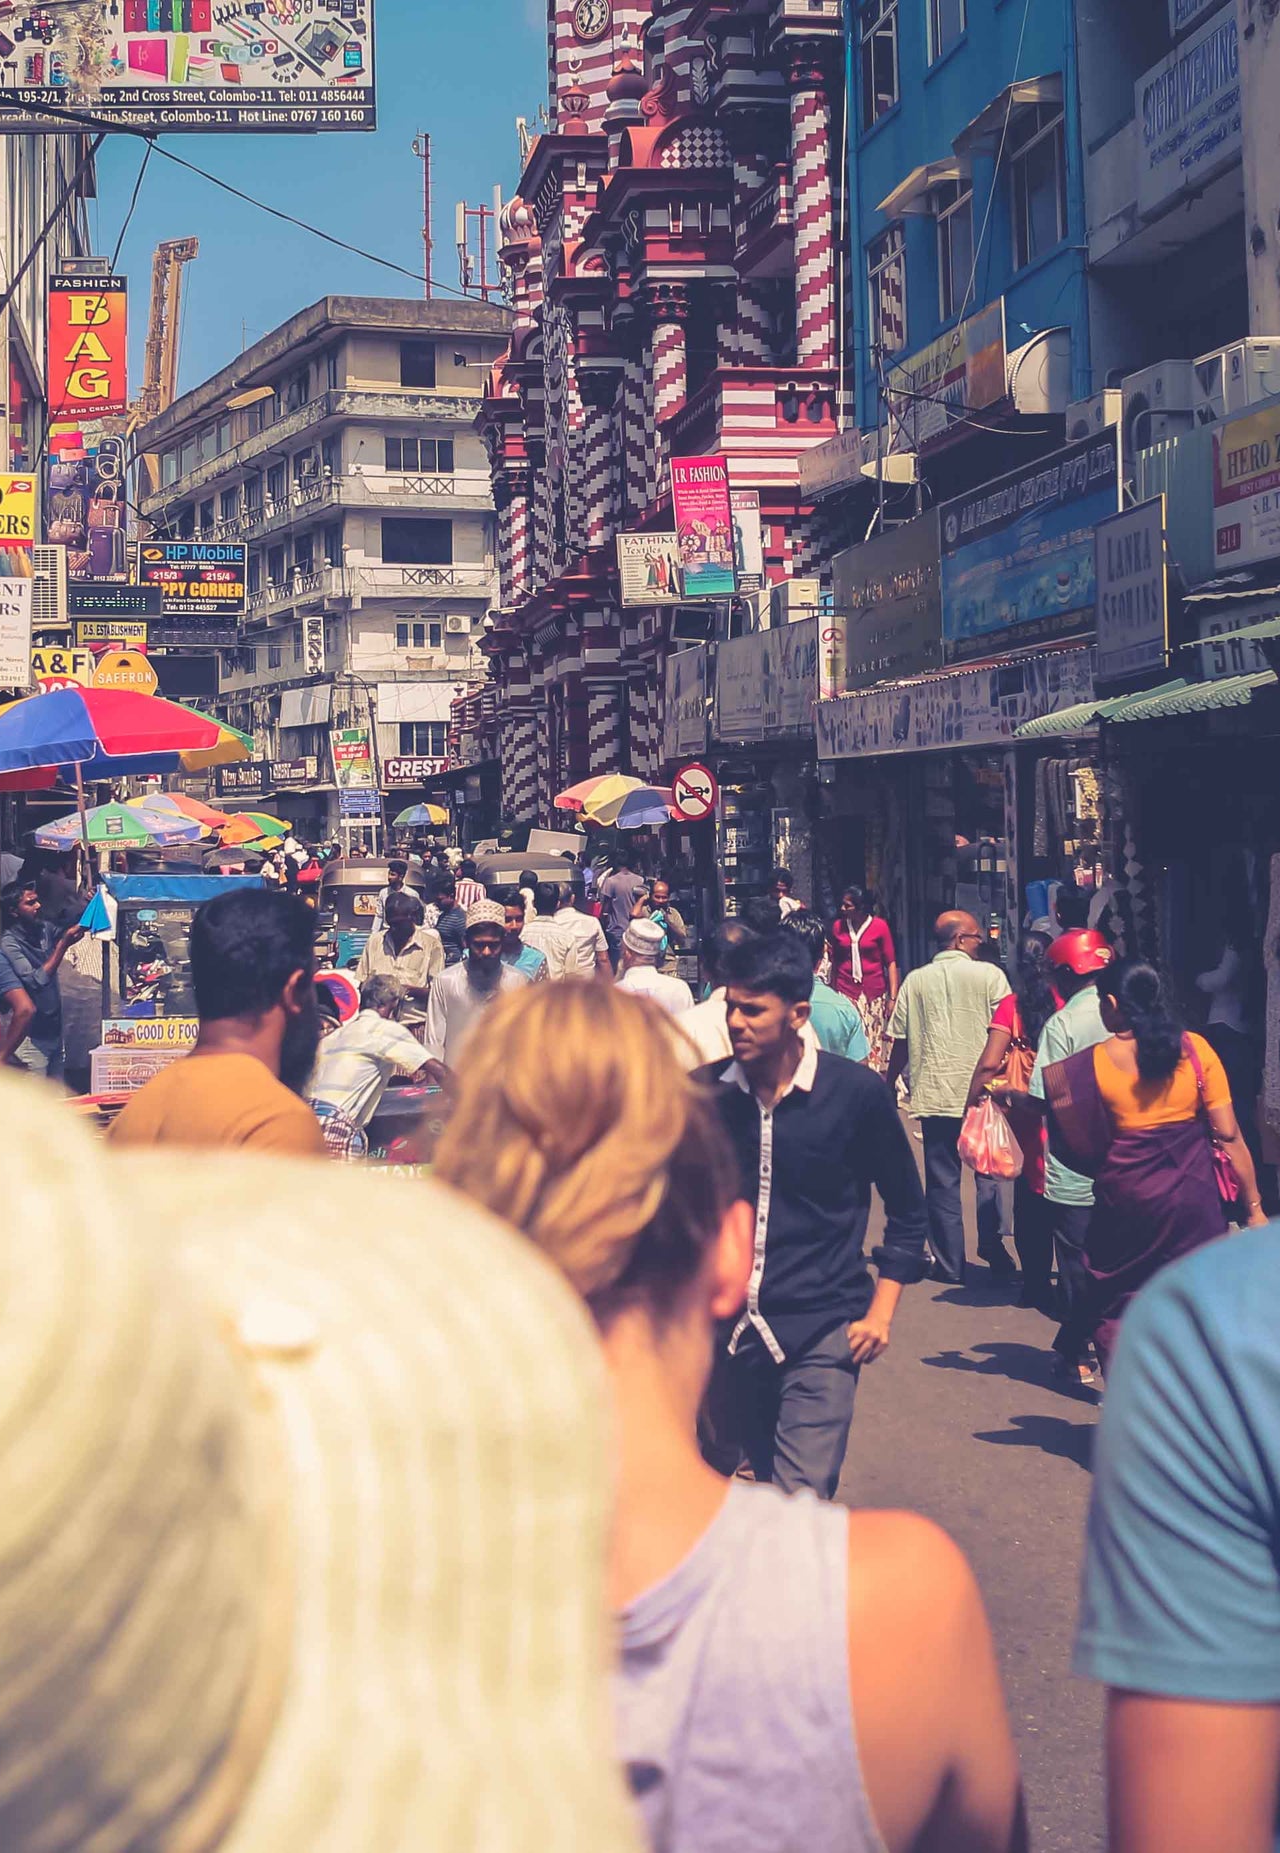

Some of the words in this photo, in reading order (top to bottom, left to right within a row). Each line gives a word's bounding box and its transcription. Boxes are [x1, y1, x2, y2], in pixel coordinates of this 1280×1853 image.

[19, 90, 61, 104] 195-2/1,
[120, 90, 139, 102] 2nd
[142, 91, 170, 102] Cross
[173, 90, 206, 103] Street,
[209, 90, 276, 102] Colombo-11.
[279, 90, 297, 102] Tel:
[299, 90, 318, 102] 011
[321, 90, 365, 102] 4856444
[91, 111, 119, 122] Main
[122, 111, 158, 123] Street,
[161, 110, 232, 122] Colombo-11.
[238, 110, 259, 122] Hot
[268, 110, 288, 122] Line:
[291, 110, 317, 122] 0767
[321, 110, 341, 122] 160
[344, 110, 364, 122] 160
[55, 279, 121, 288] FASHION
[64, 295, 112, 399] BAG
[1227, 439, 1271, 480] HERO
[689, 466, 727, 483] FASHION
[624, 537, 677, 545] FATHIM
[166, 546, 188, 560] HP
[192, 546, 243, 560] Mobile
[627, 546, 661, 554] Textiles
[1107, 527, 1152, 583] LANKA
[153, 571, 177, 580] 215/3
[206, 572, 230, 581] 215/4
[141, 582, 188, 597] PPY
[190, 582, 244, 597] CORNER
[83, 624, 95, 636] D.S.
[96, 625, 144, 637] ESTABLISHMENT
[32, 653, 47, 674] A
[50, 653, 68, 674] &
[72, 654, 86, 674] F
[98, 672, 153, 684] SAFFRON
[388, 760, 445, 777] CREST
[136, 1024, 164, 1040] GOOD
[167, 1024, 176, 1040] &
